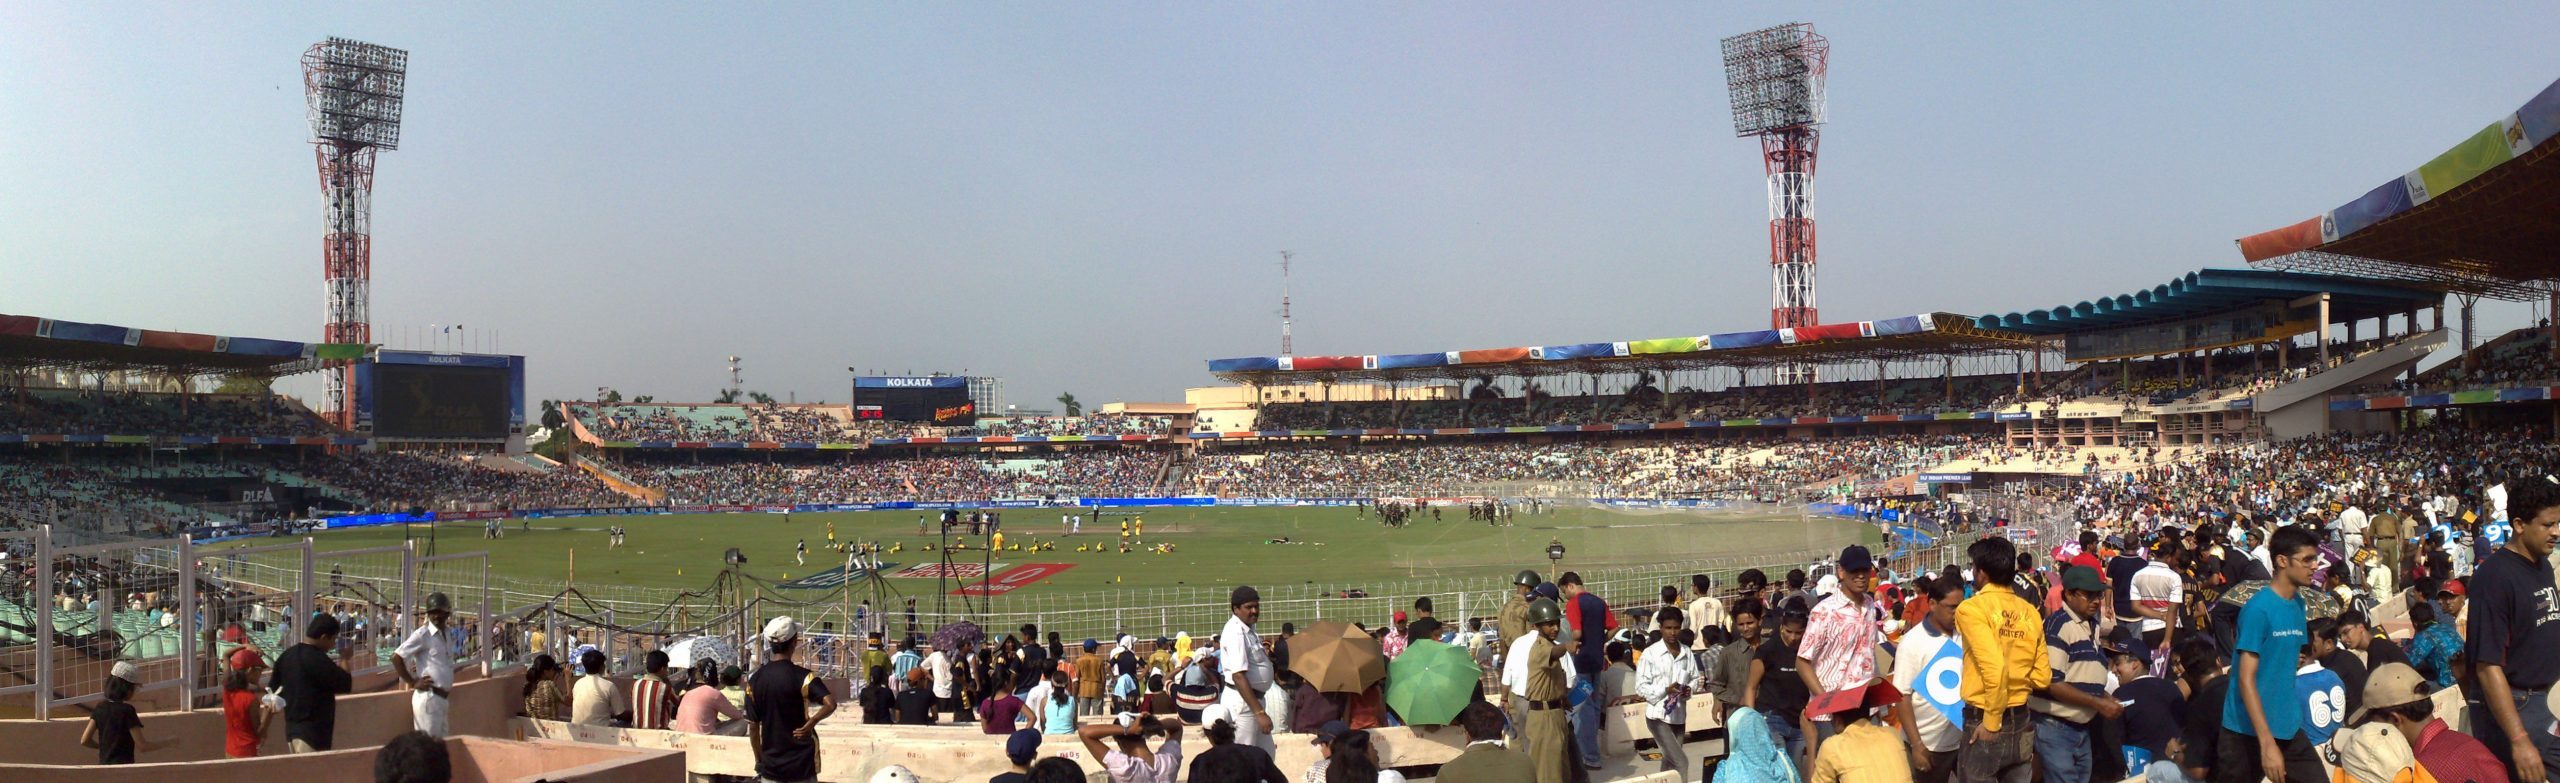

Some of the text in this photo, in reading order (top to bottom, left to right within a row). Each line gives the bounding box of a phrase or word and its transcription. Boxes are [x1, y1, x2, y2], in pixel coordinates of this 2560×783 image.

[428, 356, 461, 365] KOLKATA
[887, 378, 933, 387] KOLKATA
[2309, 685, 2346, 728] 69
